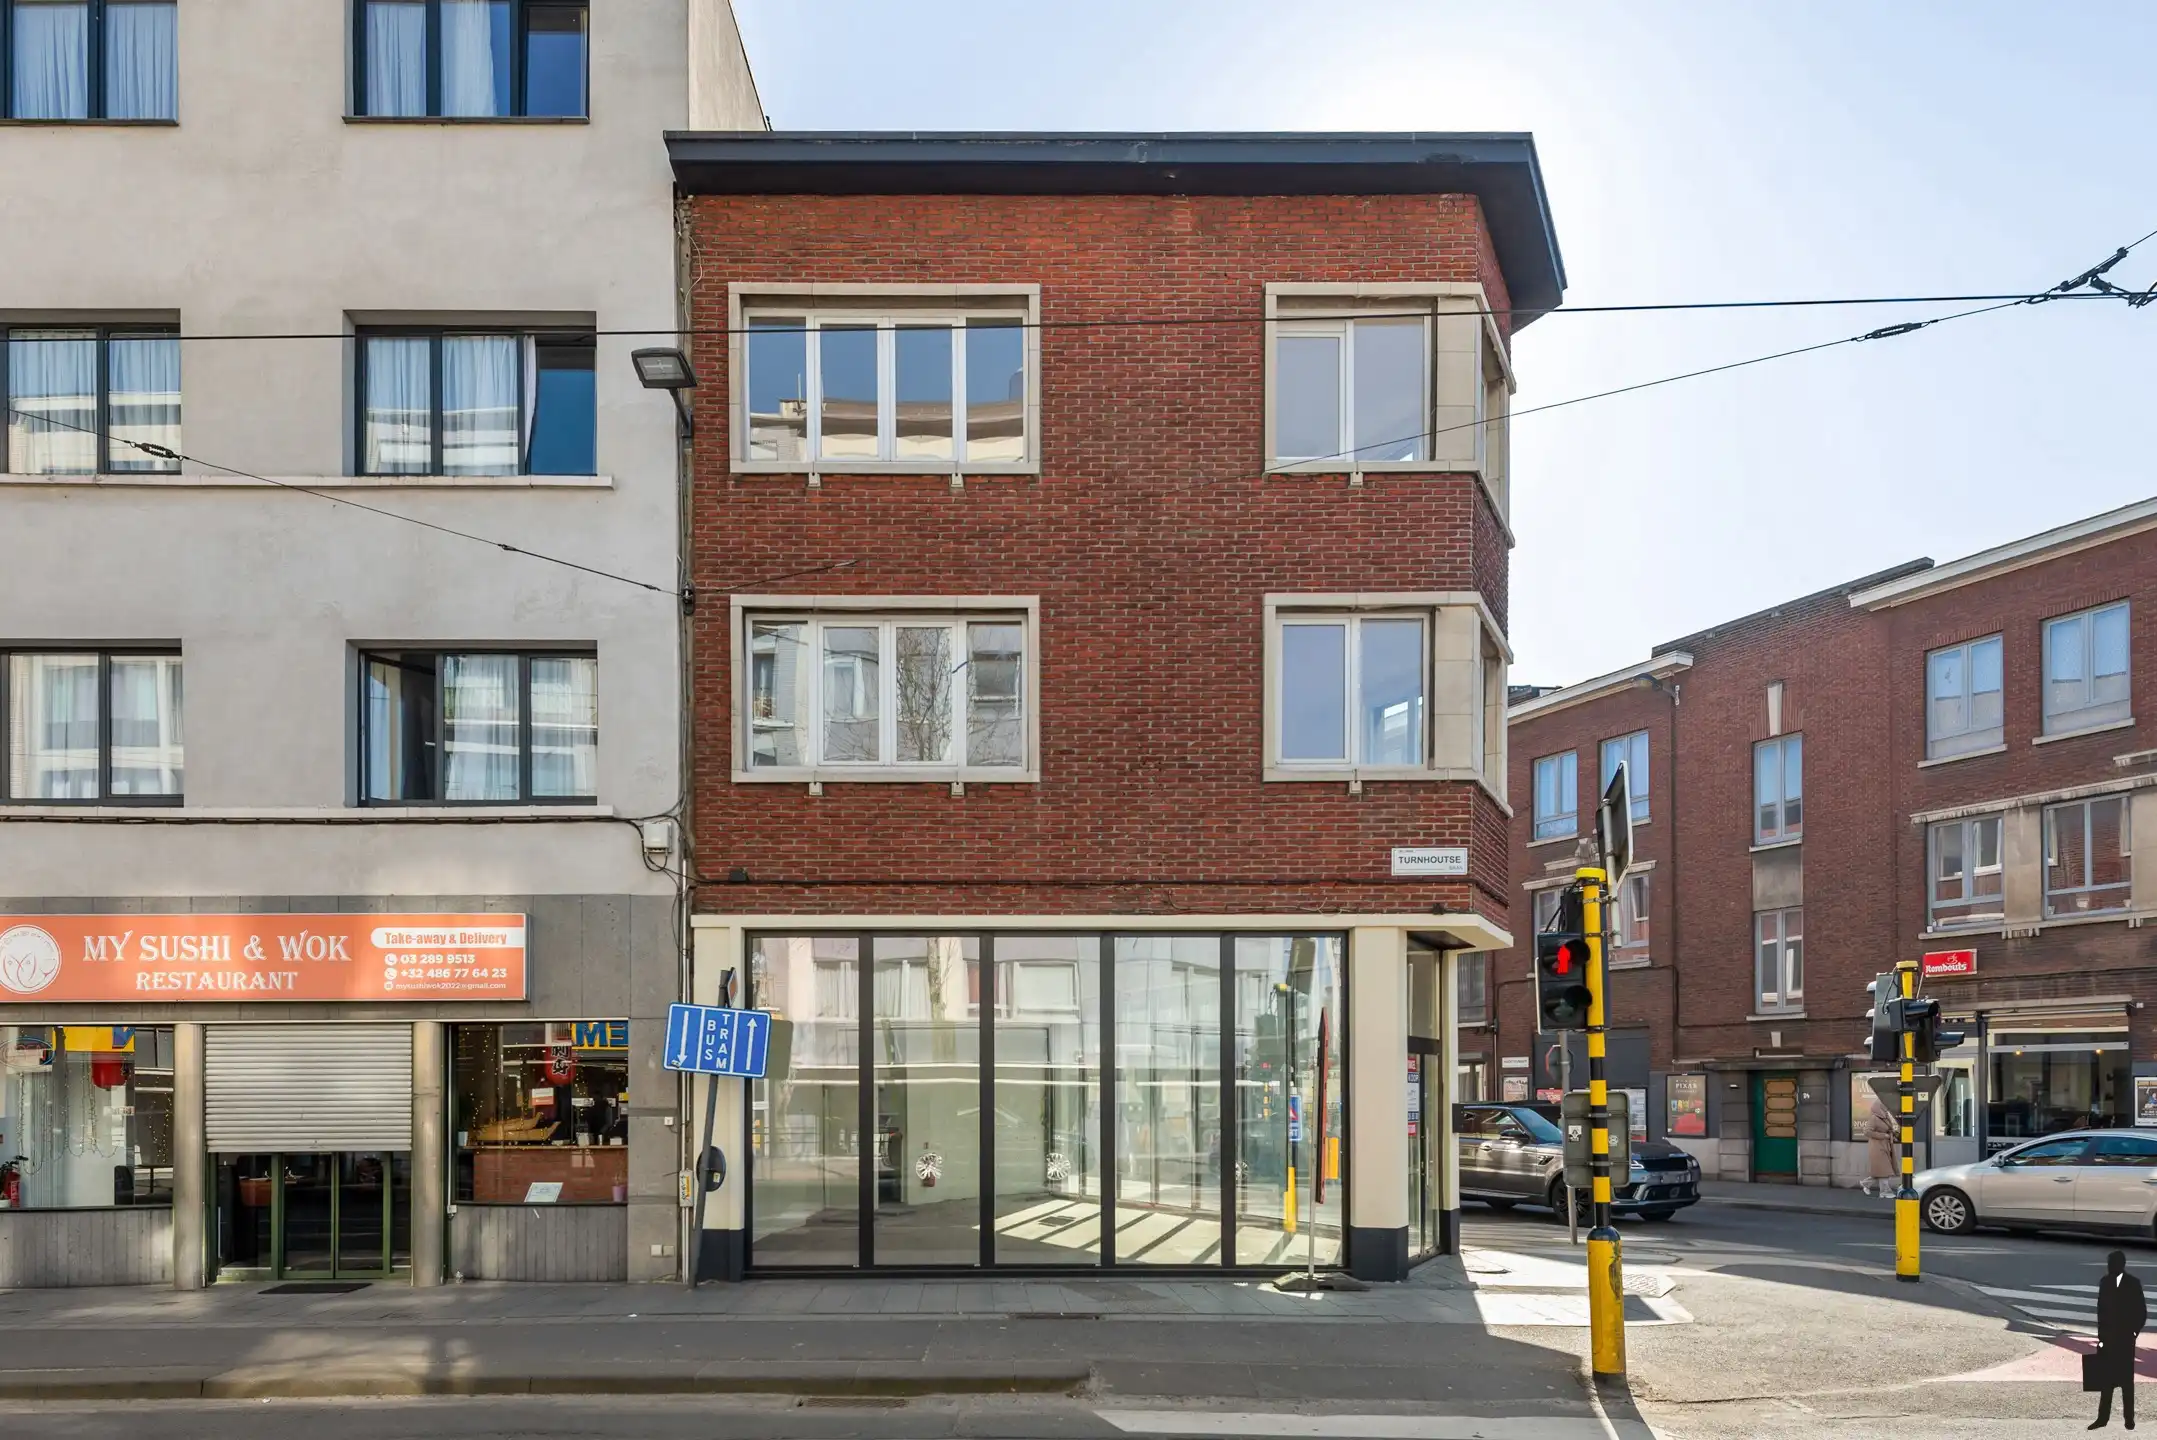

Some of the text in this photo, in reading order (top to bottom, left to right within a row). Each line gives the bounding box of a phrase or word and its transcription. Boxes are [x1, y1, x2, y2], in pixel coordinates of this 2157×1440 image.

[1398, 855, 1461, 864] TURNHOUTSE
[385, 932, 507, 945] Take-away & Delivery
[83, 929, 133, 961] MY
[139, 934, 232, 961] SUSHI
[243, 934, 267, 961] &
[277, 929, 352, 962] WOK
[400, 954, 476, 964] 03 289 9513
[400, 968, 507, 978] +32 486 77 64 23
[1925, 961, 1968, 974] Rombouts
[135, 971, 298, 991] RESTAURANT
[704, 1020, 716, 1060] BUS
[716, 1013, 731, 1069] TRAM
